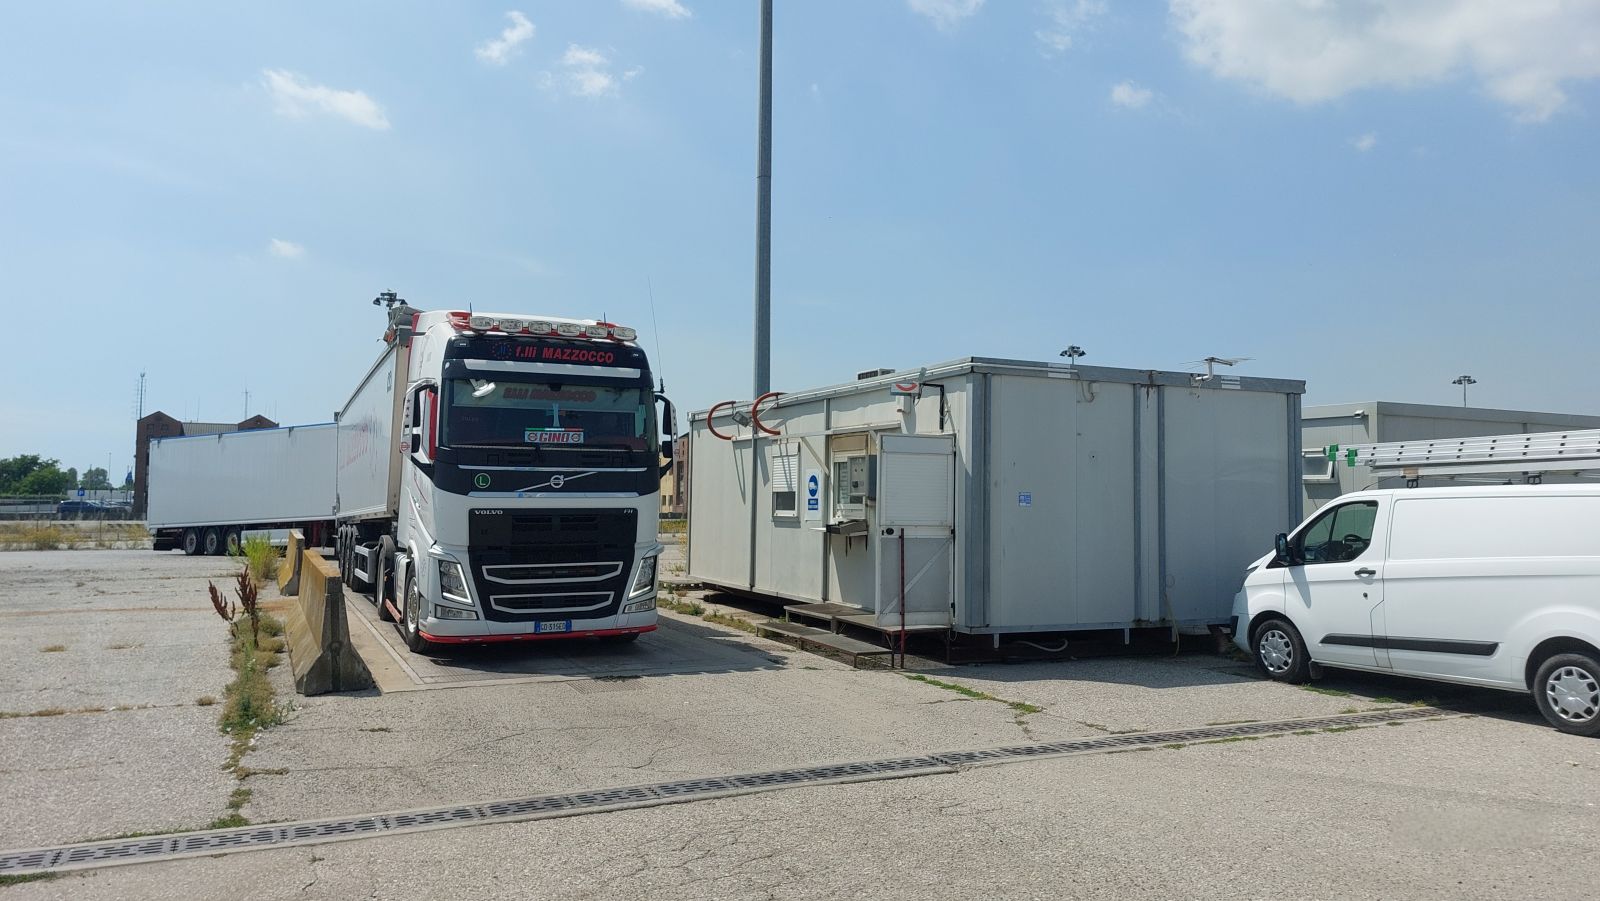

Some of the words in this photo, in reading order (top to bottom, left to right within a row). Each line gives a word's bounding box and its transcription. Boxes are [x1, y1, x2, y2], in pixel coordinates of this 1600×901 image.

[542, 347, 614, 364] MAZZOCCO
[539, 432, 570, 442] GINO
[479, 476, 487, 486] L
